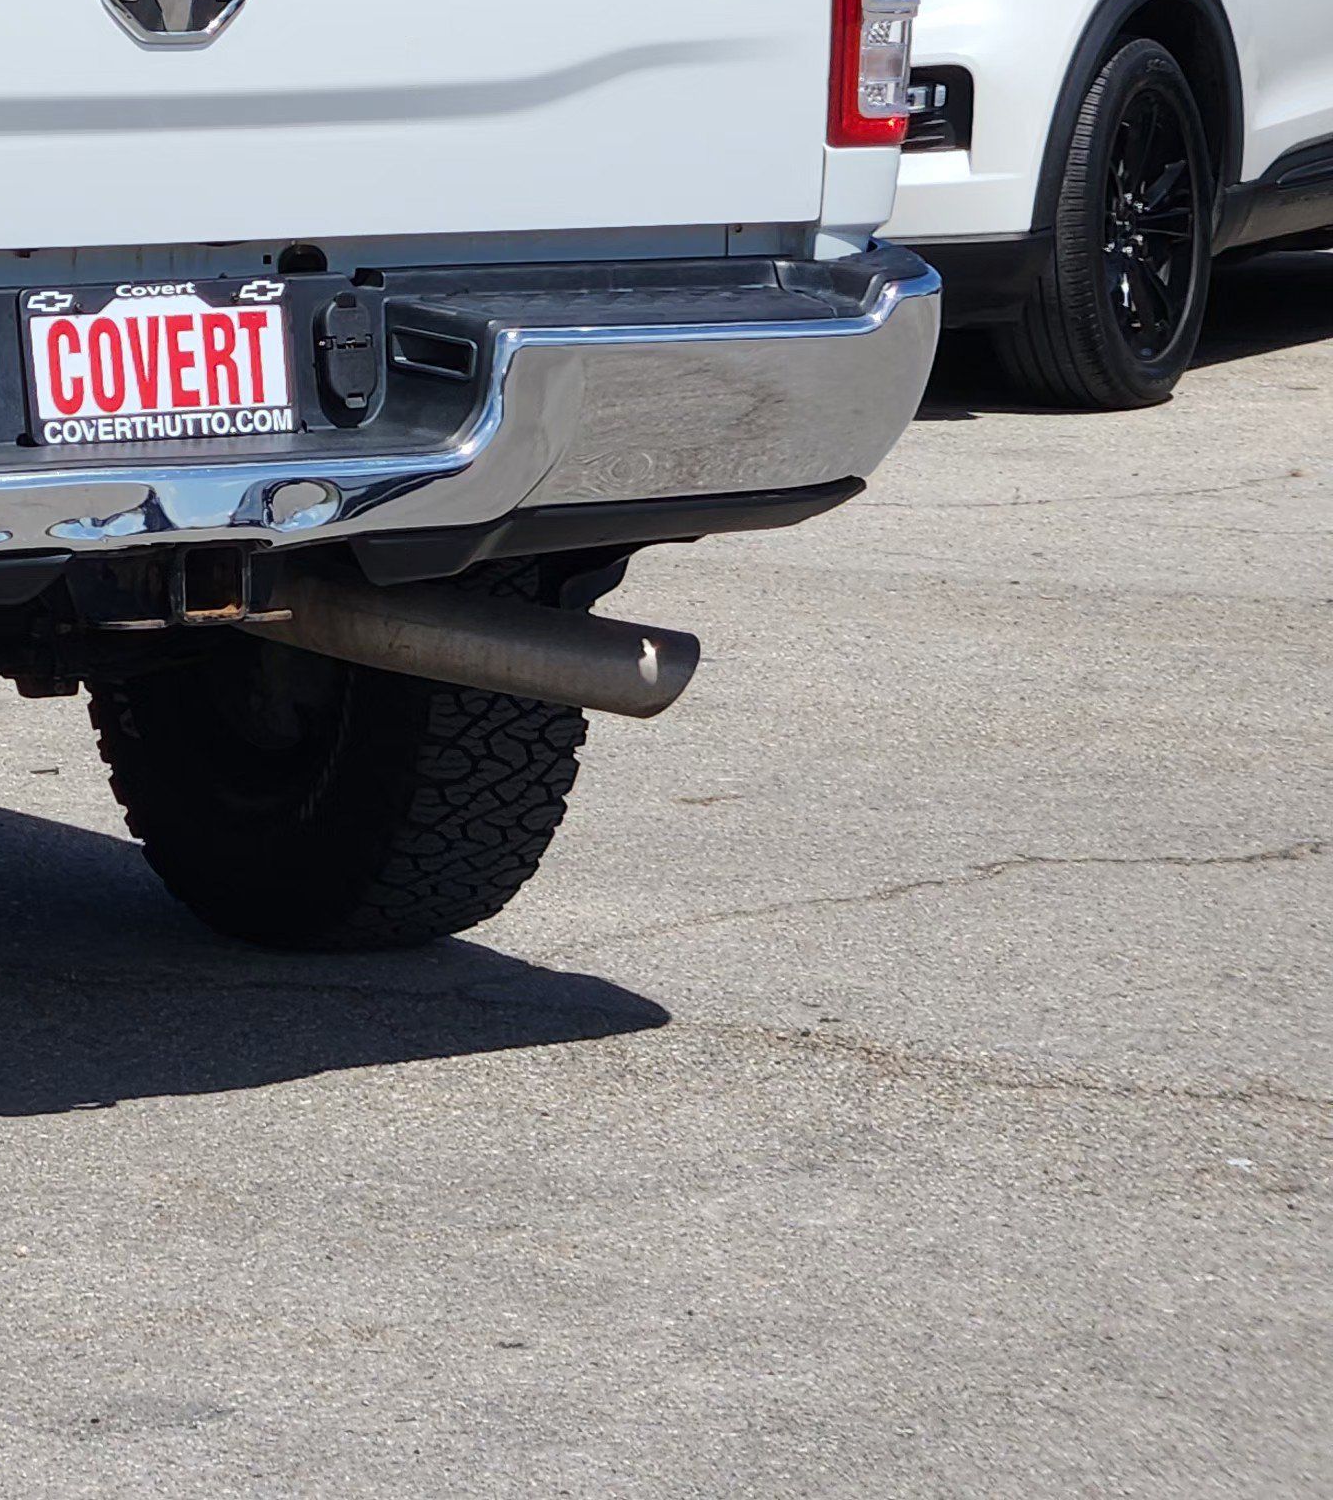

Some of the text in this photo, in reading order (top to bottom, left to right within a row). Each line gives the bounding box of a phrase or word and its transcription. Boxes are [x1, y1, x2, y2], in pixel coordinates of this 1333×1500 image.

[116, 282, 196, 298] Covert
[48, 311, 268, 415] COVERT
[44, 409, 293, 445] COVERTHUTTO.COM
